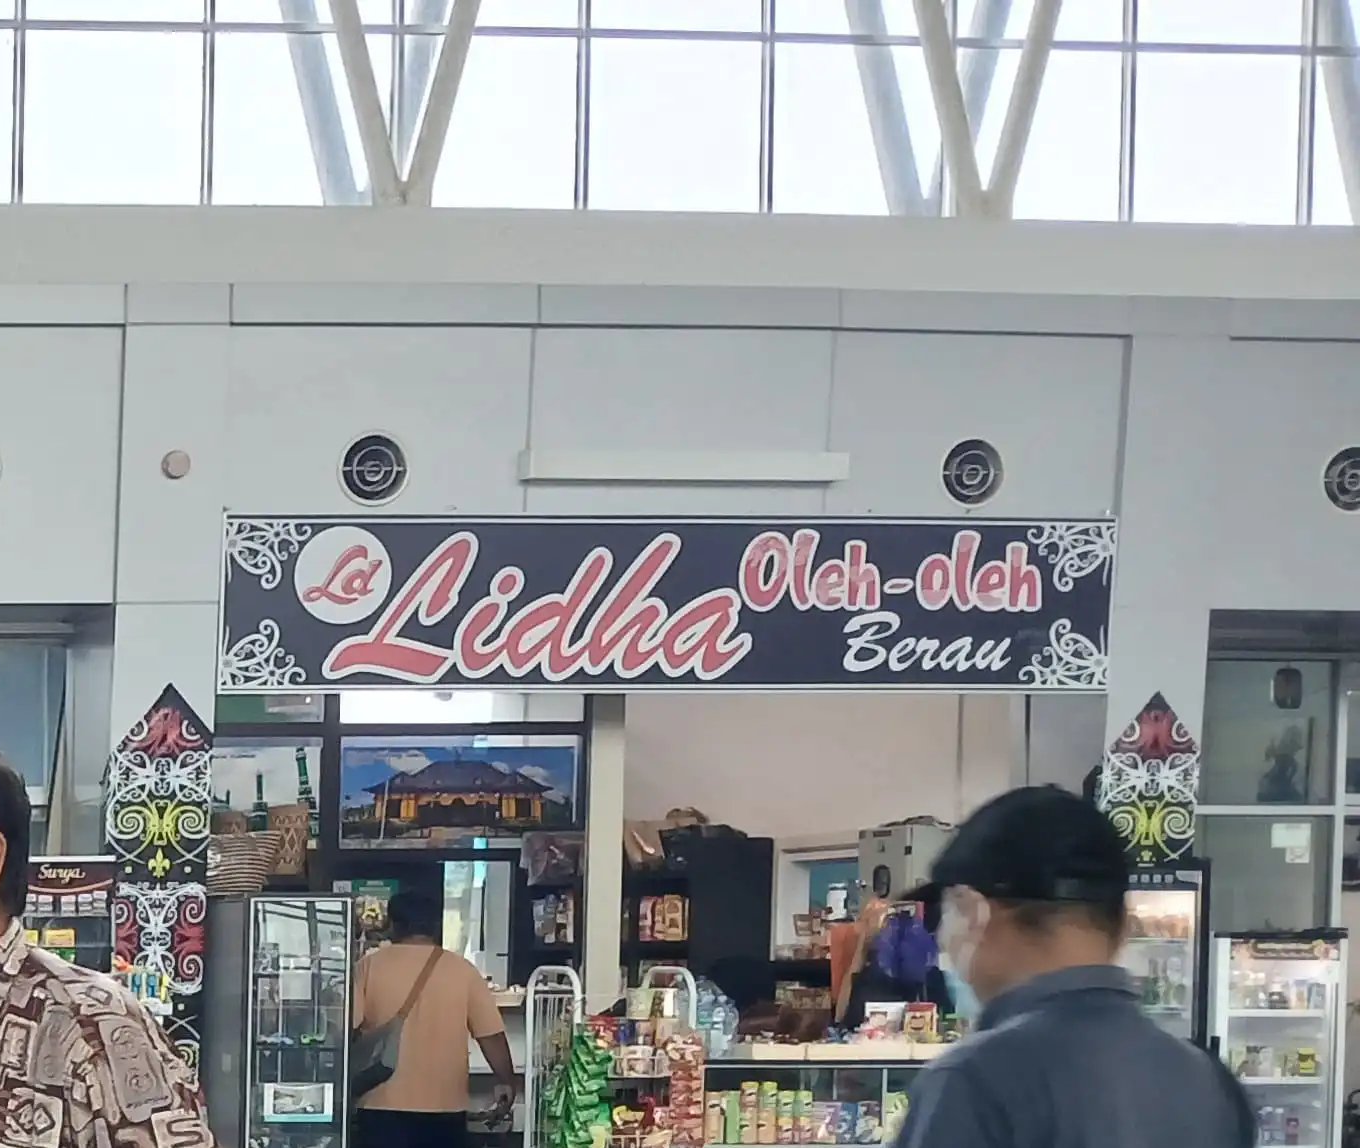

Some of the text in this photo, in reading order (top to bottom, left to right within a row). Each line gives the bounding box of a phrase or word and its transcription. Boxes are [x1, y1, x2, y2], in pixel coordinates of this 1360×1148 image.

[739, 529, 1042, 612] Oleh-oleh
[322, 531, 752, 683] Lidha
[843, 612, 1012, 672] Berau
[38, 864, 86, 884] Surya
